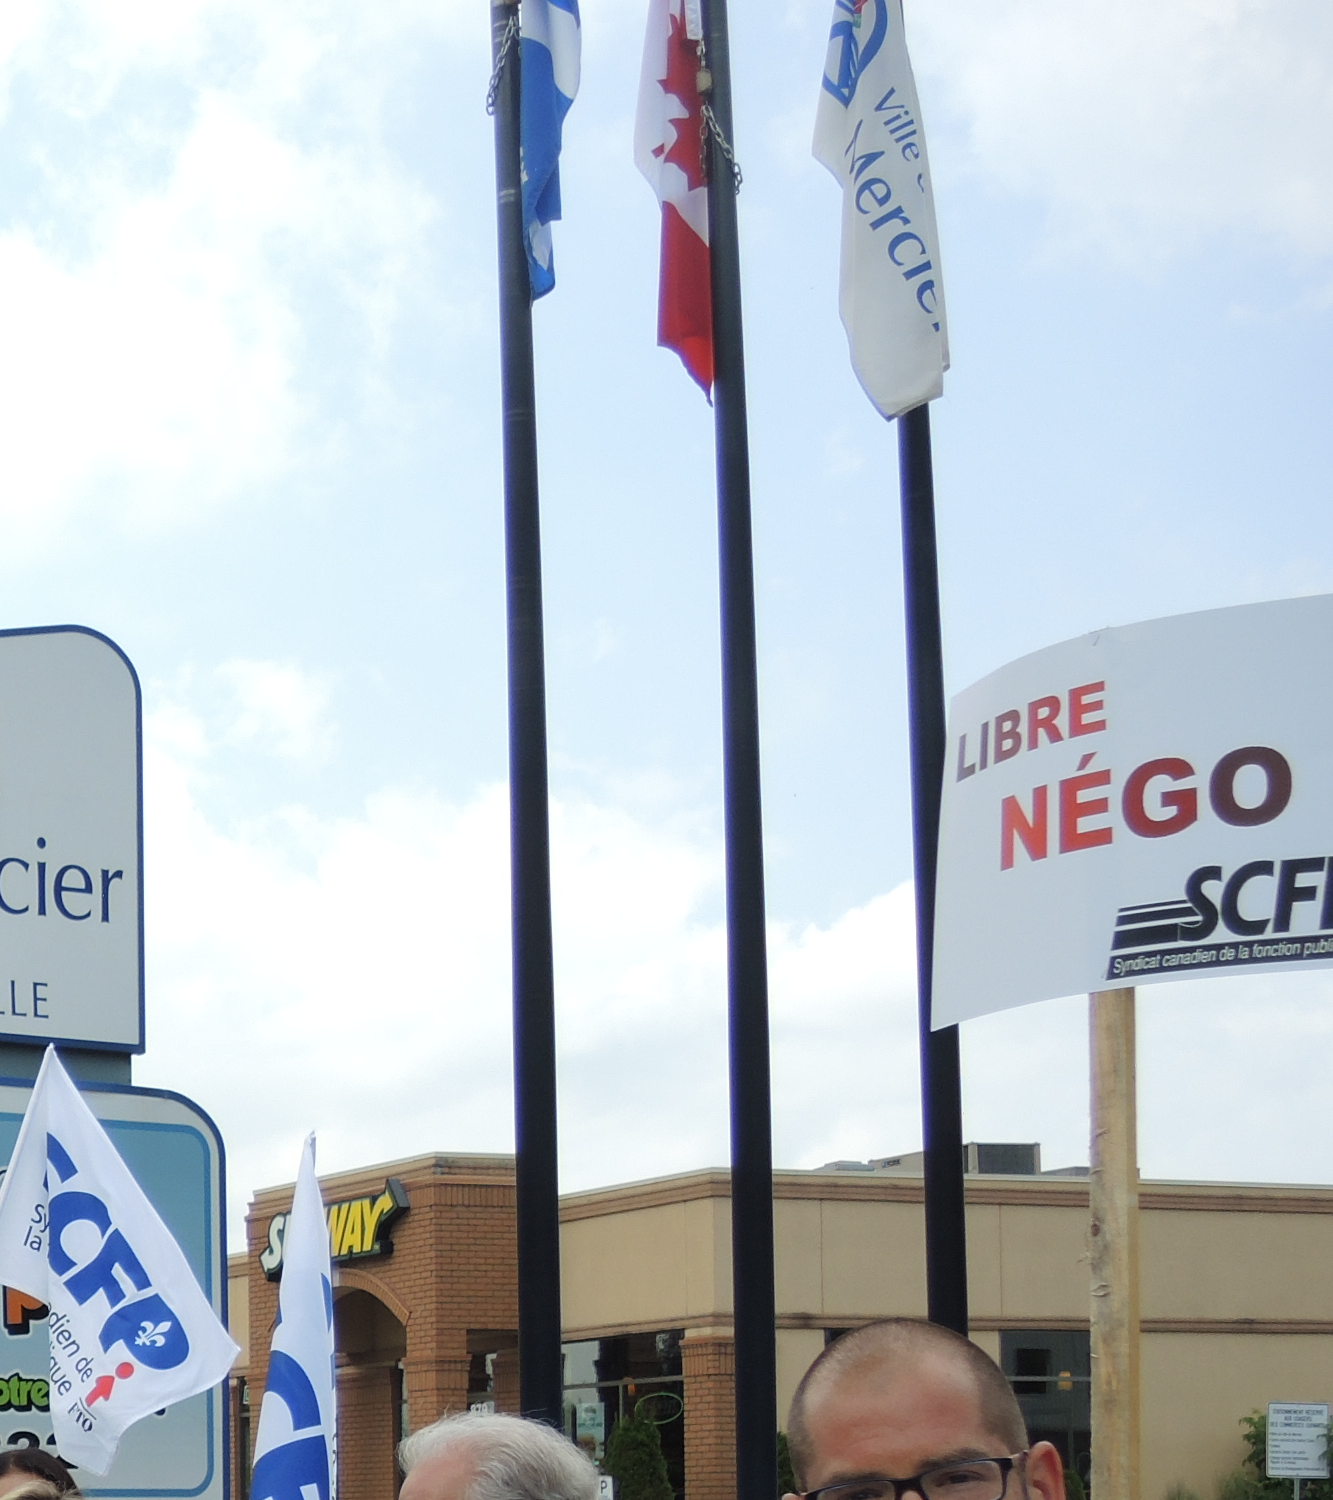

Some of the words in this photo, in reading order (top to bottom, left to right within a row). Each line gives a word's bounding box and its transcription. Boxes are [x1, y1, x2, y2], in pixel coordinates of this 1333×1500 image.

[874, 86, 919, 162] Ville
[955, 680, 1107, 784] LIBRE
[1001, 746, 1292, 871] NÉGO
[1113, 955, 1160, 976] Syndicat
[1162, 950, 1216, 967] canadien
[1219, 946, 1234, 960] de
[1238, 945, 1249, 959] la
[1251, 941, 1301, 958] fonction
[260, 1188, 394, 1273] SWAY
[75, 1357, 94, 1384] de
[67, 1401, 94, 1433] FTQ
